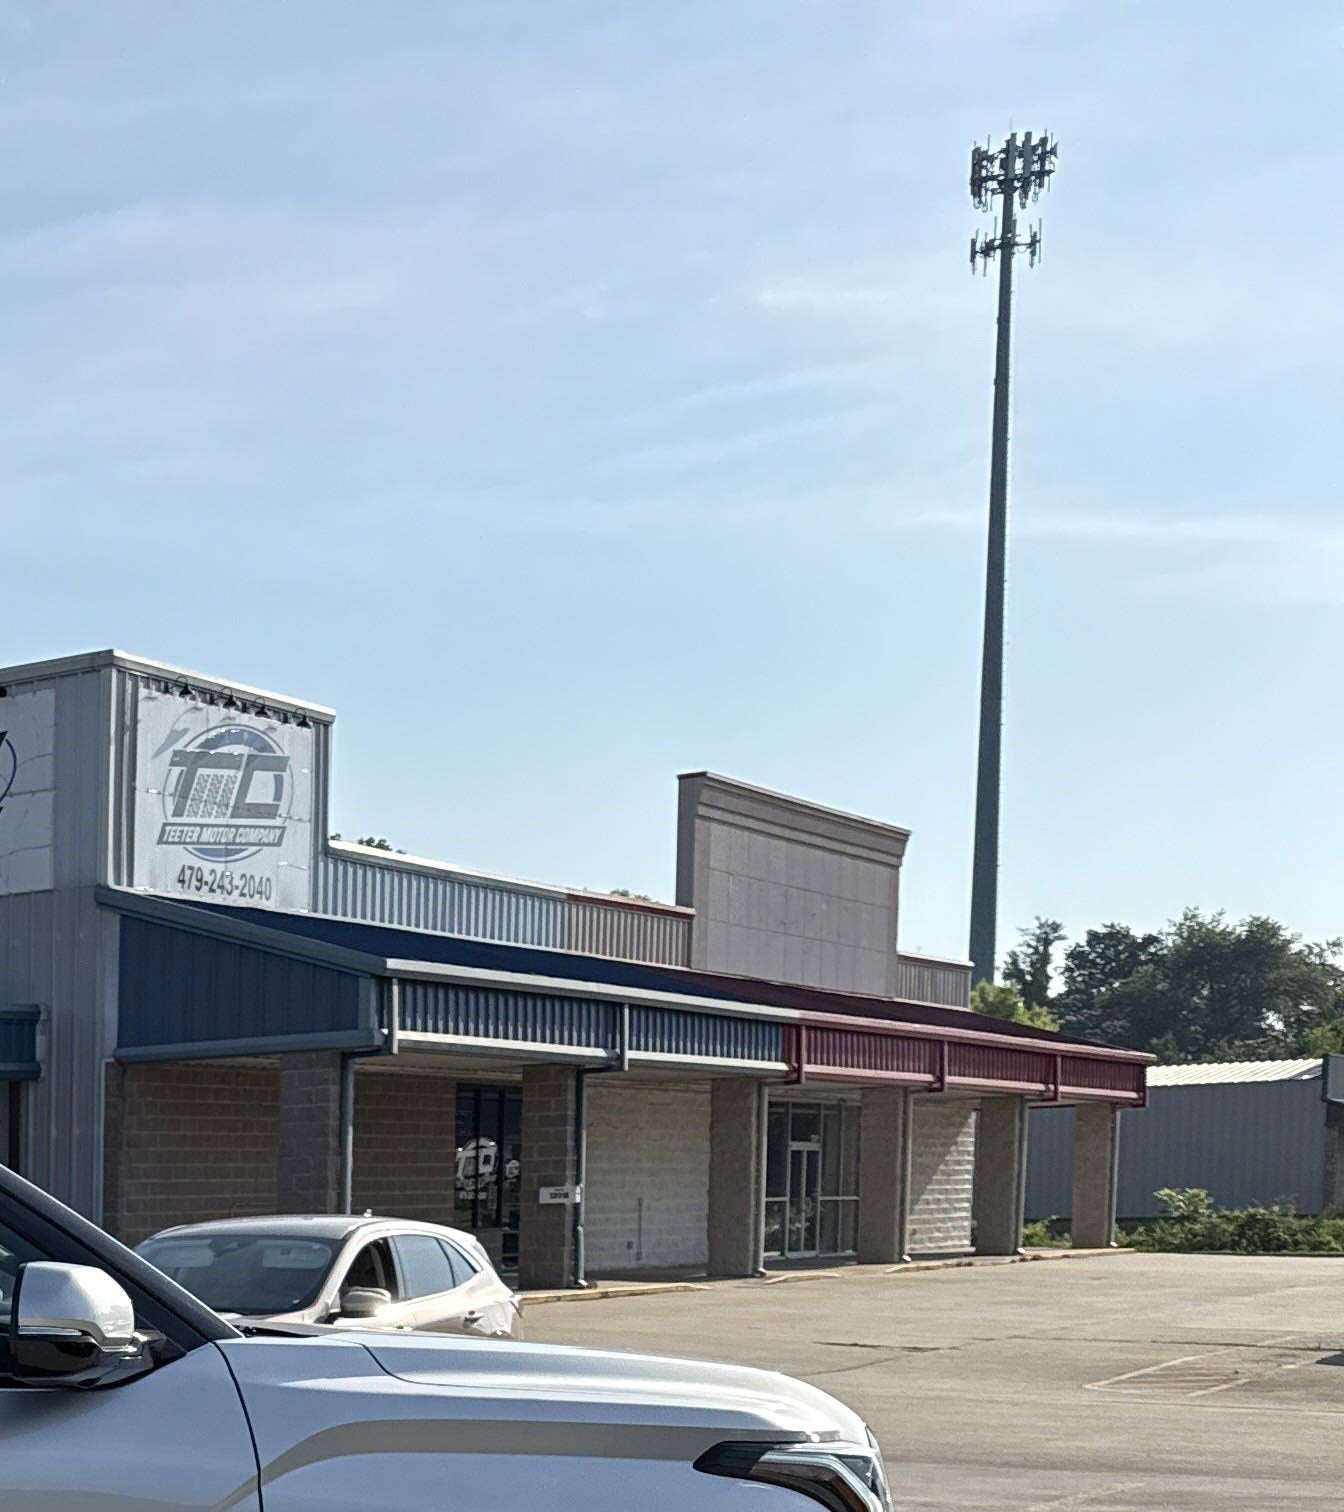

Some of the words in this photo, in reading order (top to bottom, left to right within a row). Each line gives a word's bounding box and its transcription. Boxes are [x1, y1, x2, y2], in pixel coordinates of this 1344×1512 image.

[162, 826, 200, 843] TEETER
[199, 826, 237, 843] MOTOR
[235, 827, 282, 844] COMPANY
[177, 864, 272, 901] 479-243-2040
